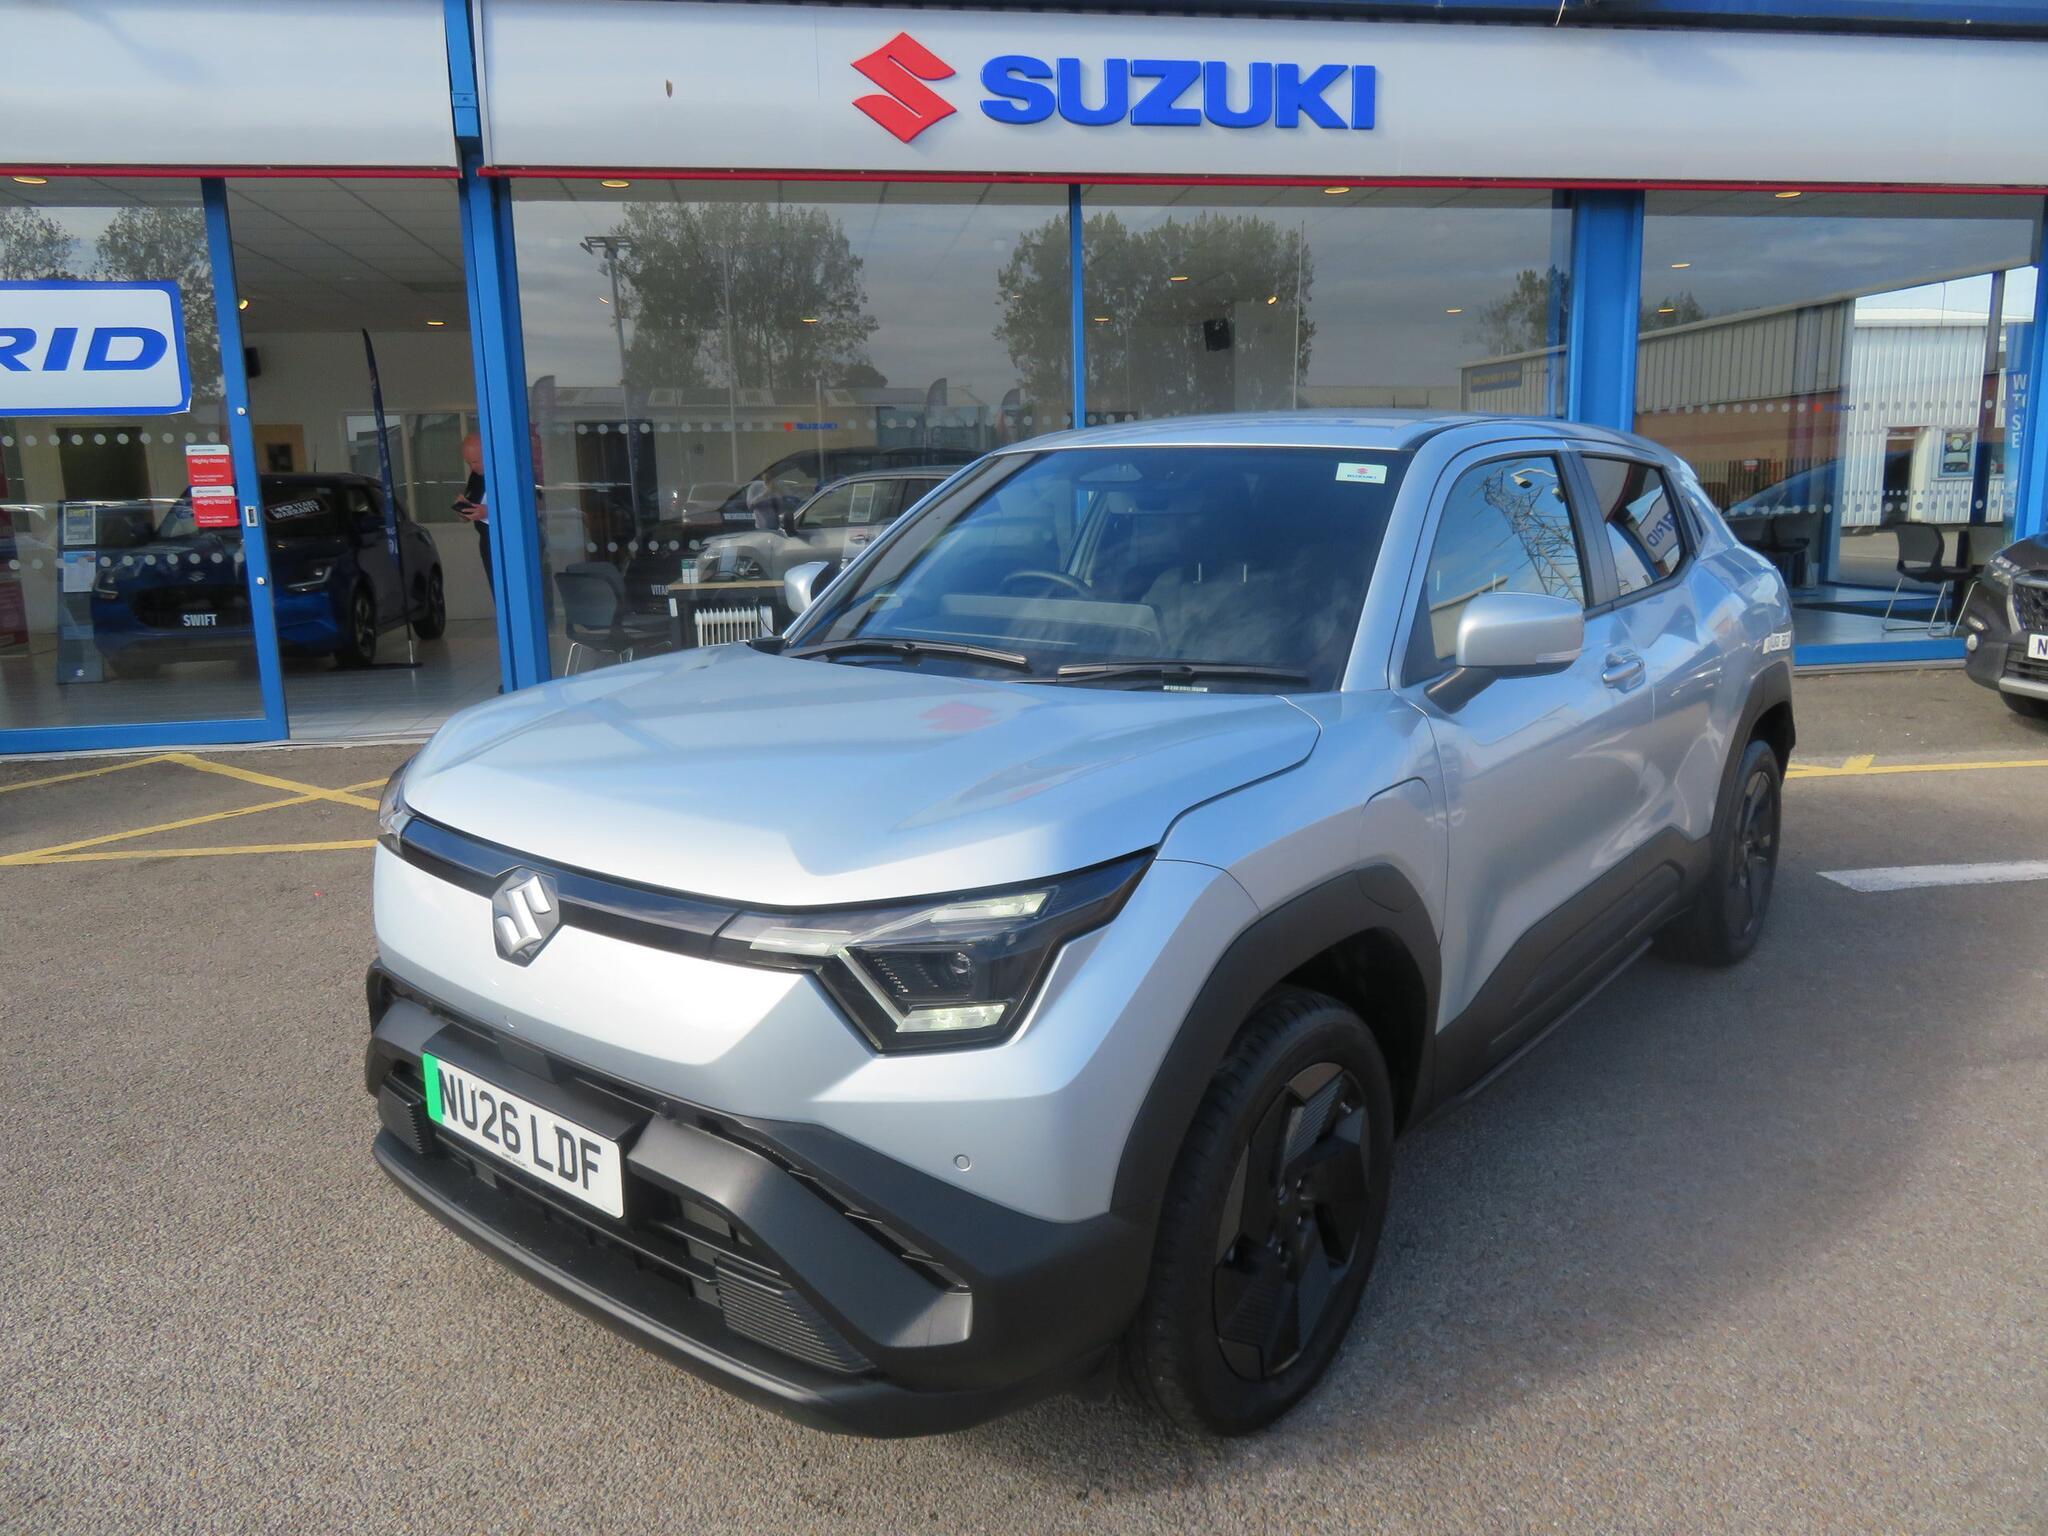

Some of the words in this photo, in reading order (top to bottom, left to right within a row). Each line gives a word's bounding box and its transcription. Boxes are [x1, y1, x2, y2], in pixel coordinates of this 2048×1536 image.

[980, 55, 1376, 130] SUZUKI
[183, 614, 217, 627] SWIFT
[437, 1068, 521, 1154] NU26
[530, 1113, 601, 1190] LDF
